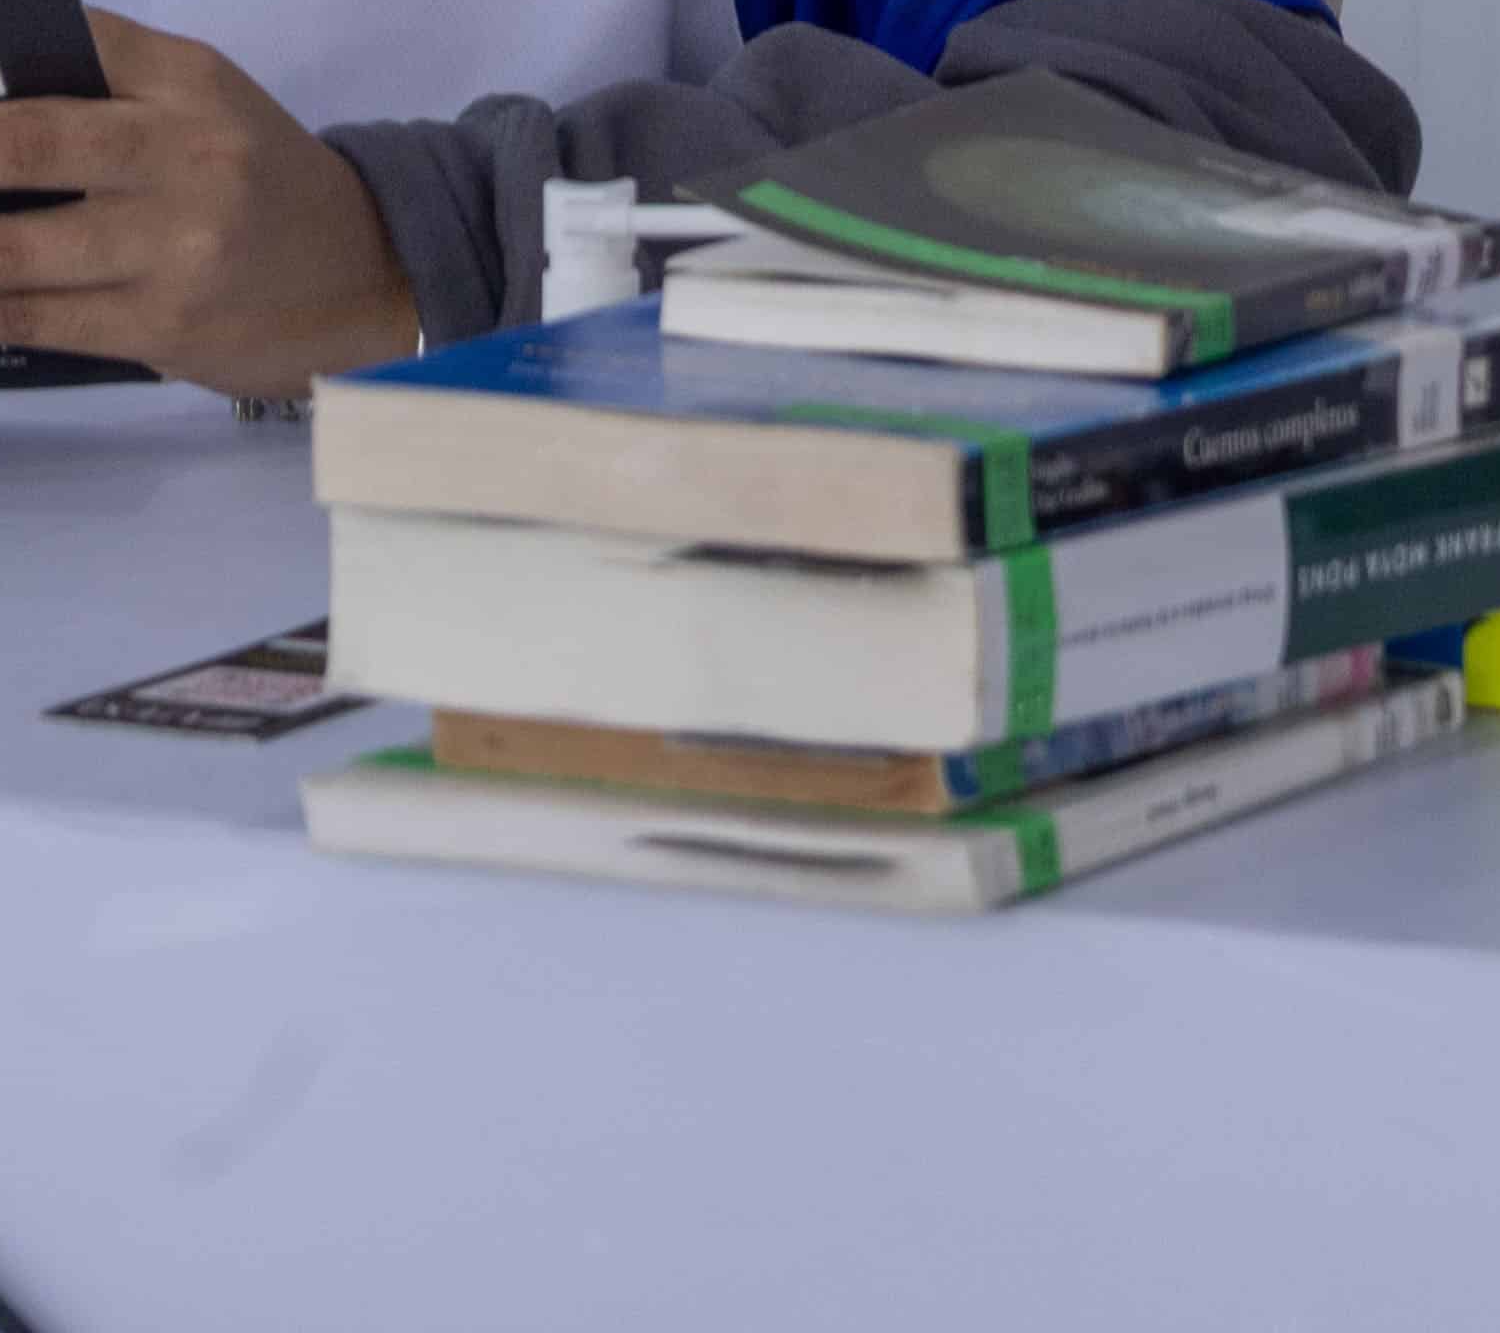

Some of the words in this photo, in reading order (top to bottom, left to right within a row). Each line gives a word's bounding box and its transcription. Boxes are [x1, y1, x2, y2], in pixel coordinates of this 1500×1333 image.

[1183, 423, 1259, 469] Cuentos
[1262, 397, 1361, 453] completos
[1297, 559, 1360, 598] PONS
[1366, 537, 1426, 580] MOYA
